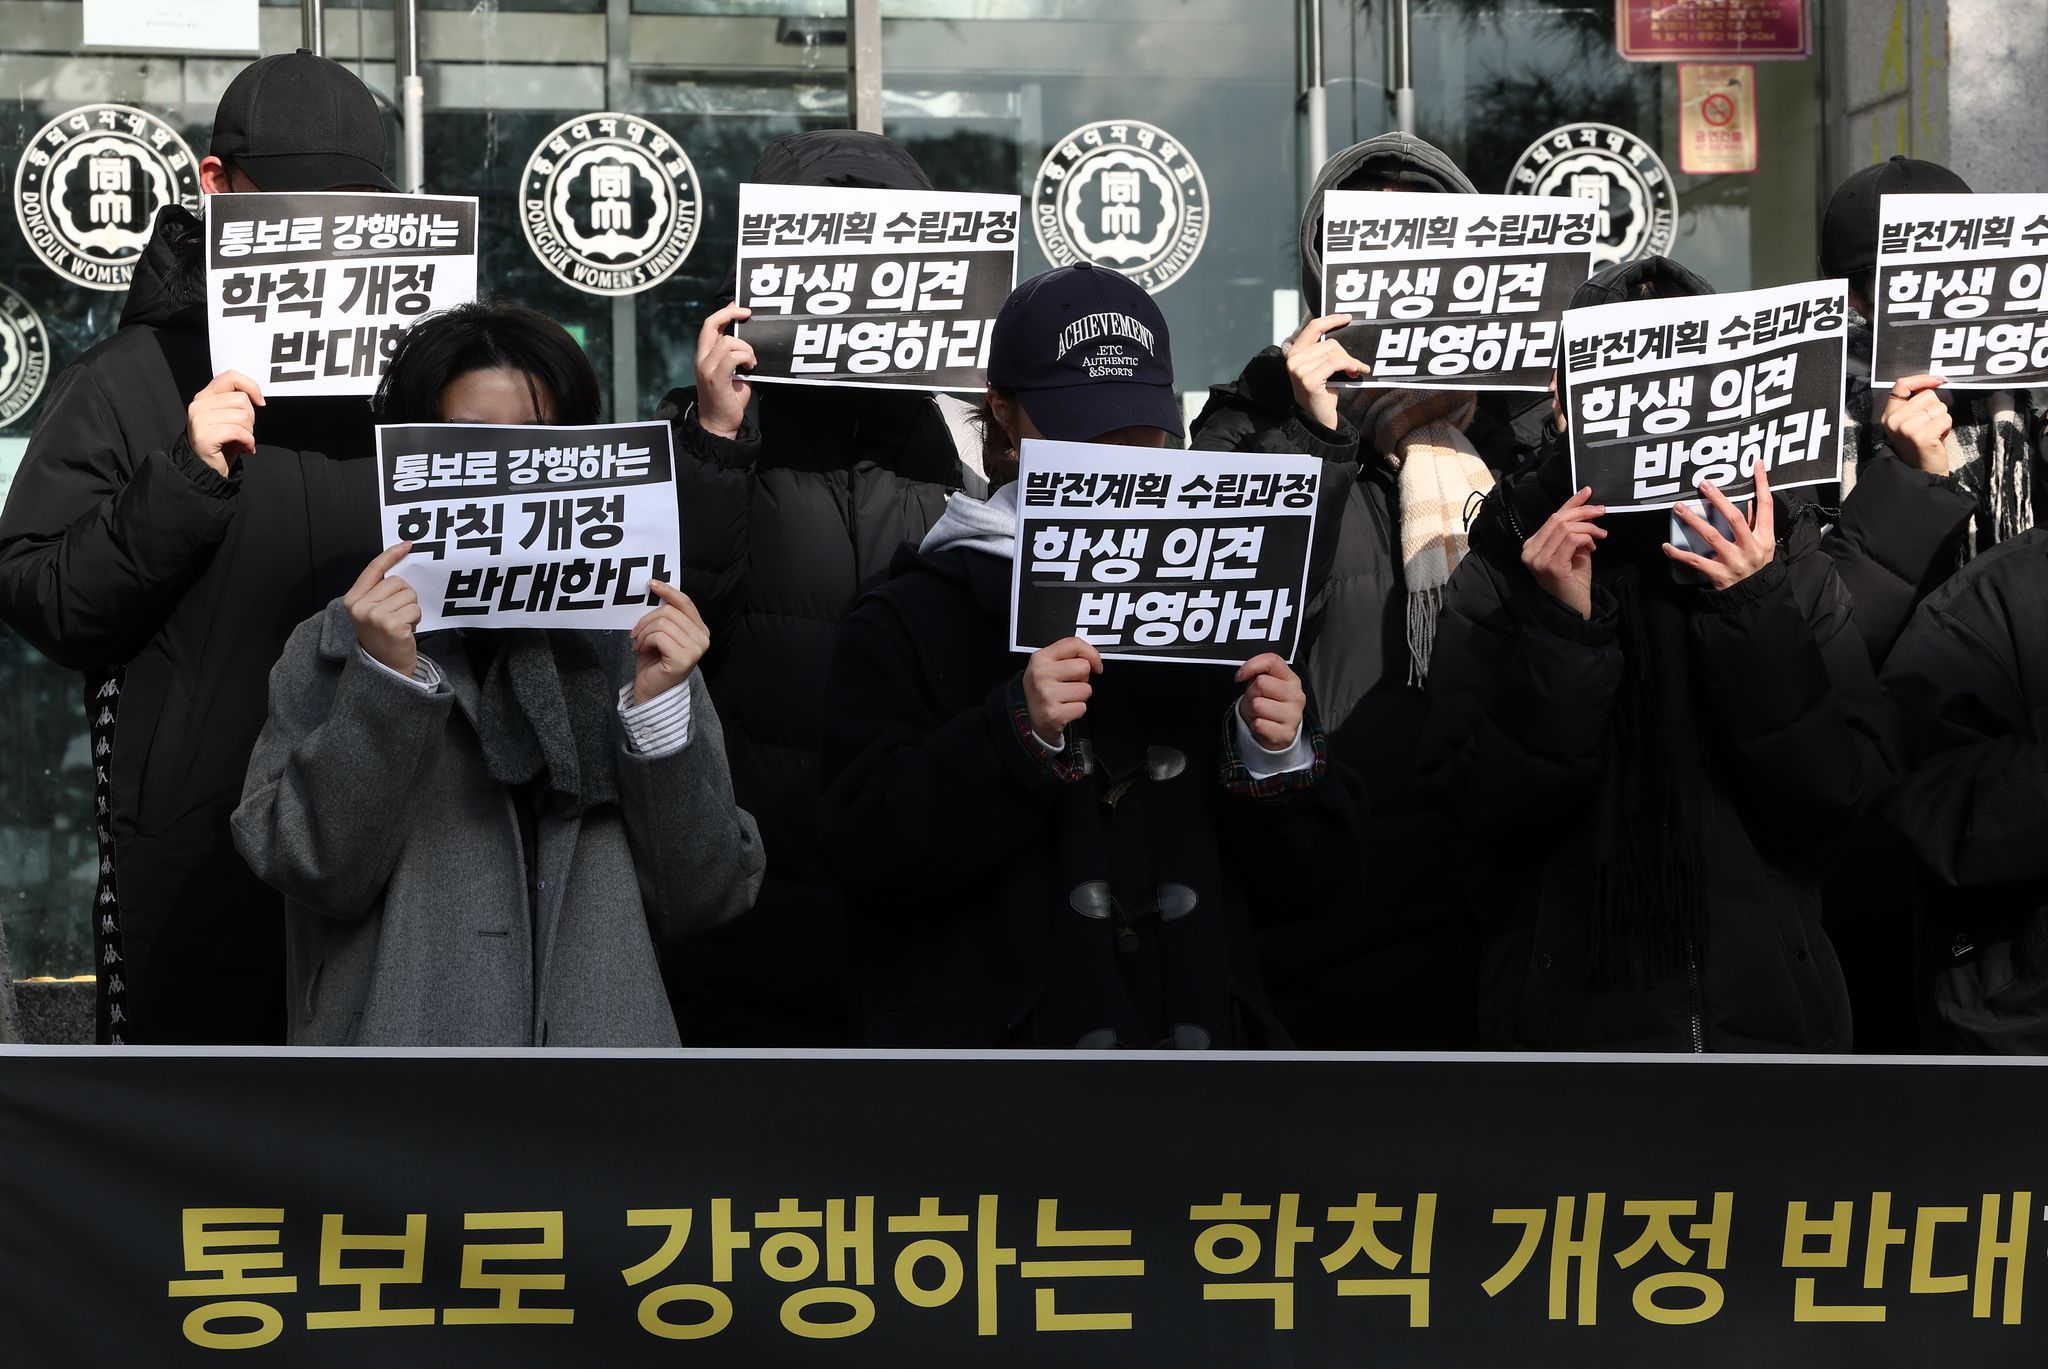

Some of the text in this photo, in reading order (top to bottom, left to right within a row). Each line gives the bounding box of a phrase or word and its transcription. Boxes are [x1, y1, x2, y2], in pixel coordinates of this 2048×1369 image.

[28, 110, 189, 171] 동덕여자대학교
[531, 118, 687, 178] 동덕여자대학교
[1045, 124, 1195, 184] 동덕여자대학교
[1516, 128, 1663, 186] 동덕여자대학교
[22, 191, 69, 266] DONGDUK
[217, 214, 459, 258] 통보로 강행하는
[527, 199, 695, 289] DONGDUK WOMEN'S UNIVERSITY
[742, 211, 1017, 246] 발전계획 수립과정
[1038, 204, 1082, 267] DONGDU
[1154, 205, 1202, 281] UNIVERSITY
[1327, 213, 1595, 252] 발전계획 수립과정
[1881, 215, 2015, 254] 발전계획
[221, 264, 436, 323] 학칙 개정
[749, 260, 970, 315] 학생 의견
[1334, 262, 1548, 320] 학생 의견
[1887, 266, 1997, 320] 학생
[1056, 312, 1154, 361] ACHIEVEMENT
[1082, 357, 1139, 366] AUTHENTIC
[1097, 345, 1123, 356] .ETC
[1569, 296, 1844, 373] 발전계획 수립과정
[1089, 366, 1133, 377] &SPORTS
[1582, 352, 1799, 438] 학생 의견
[392, 443, 651, 492] 통보로 강행하는
[1633, 408, 1831, 500] 반영하라
[1025, 472, 1318, 509] 발전계획 수립과정
[397, 494, 625, 560] 학칙 개정
[1031, 526, 1265, 583] 학생 의견
[441, 554, 671, 617] 반대한다
[1074, 588, 1293, 647] 반영하라
[168, 1191, 2048, 1349] 통보로 강행하는 학칙 개정 반대
